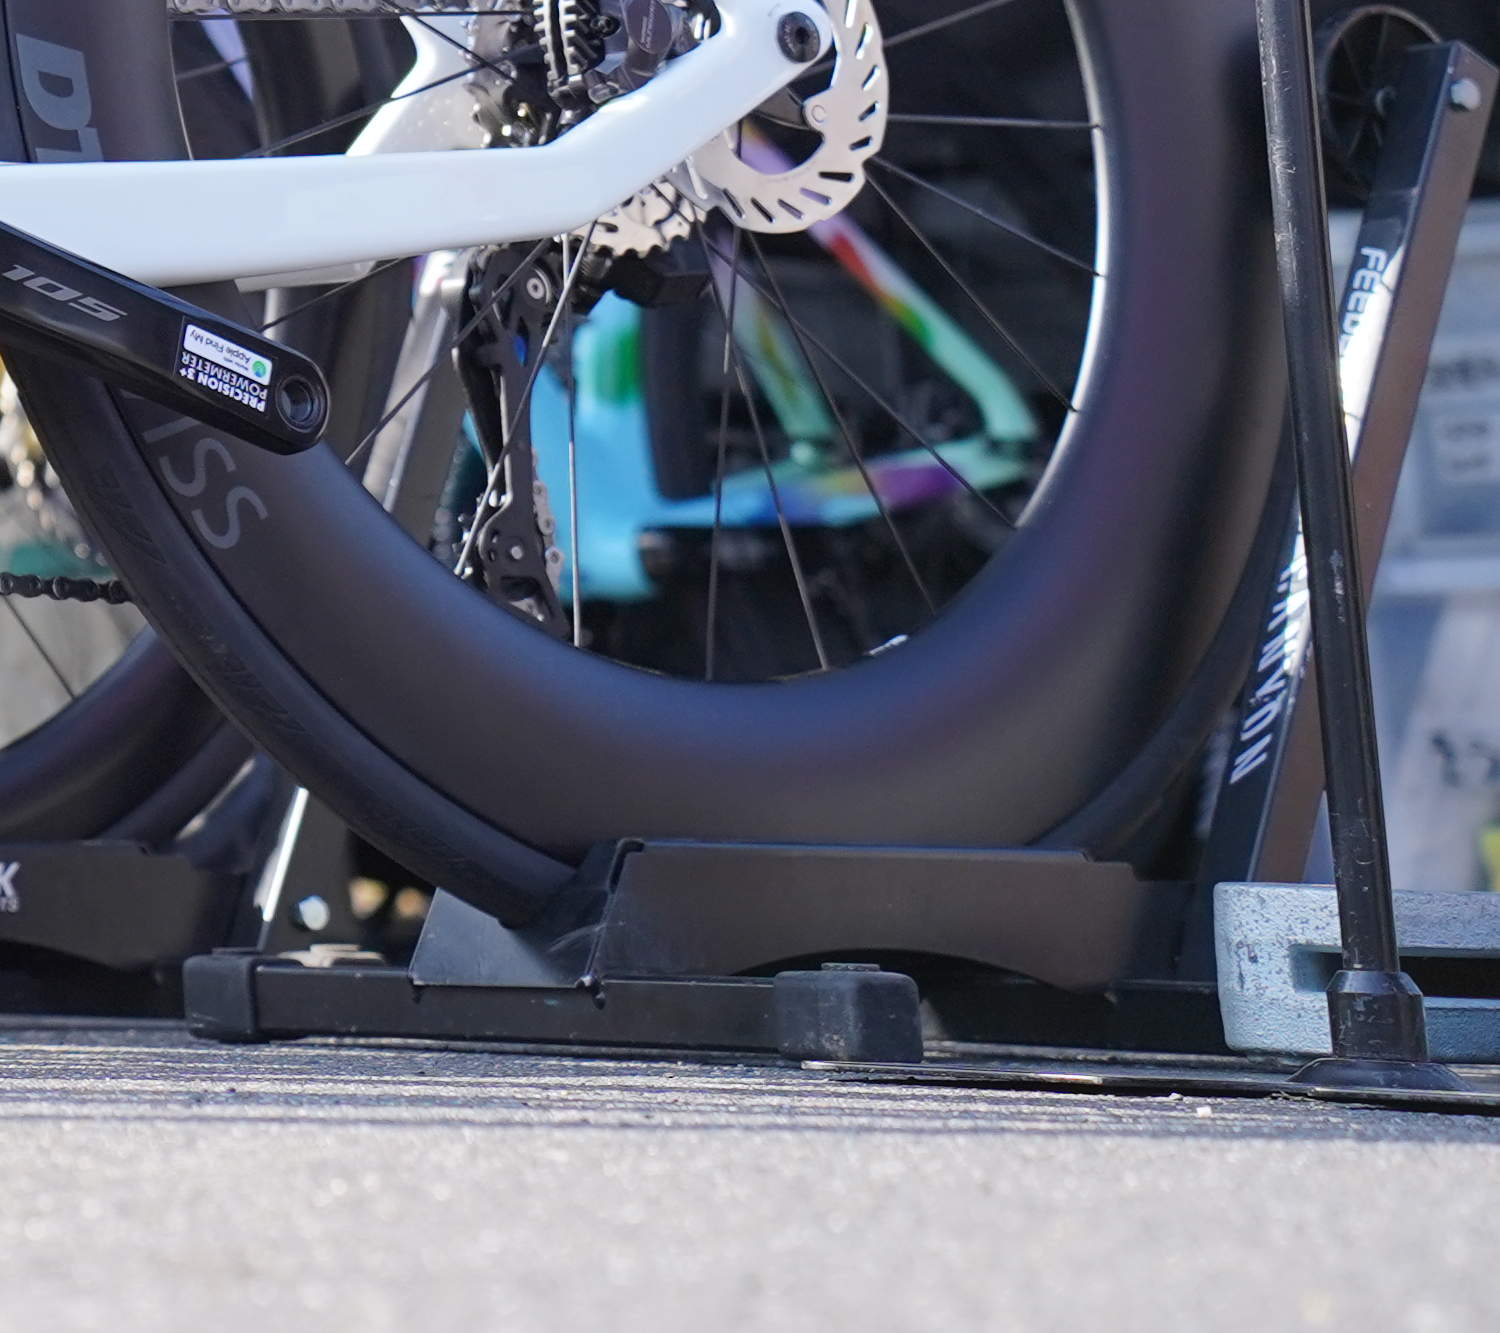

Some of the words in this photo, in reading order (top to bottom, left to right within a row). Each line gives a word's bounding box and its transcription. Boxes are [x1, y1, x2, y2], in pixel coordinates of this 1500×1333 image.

[1, 263, 129, 322] 105
[1338, 245, 1388, 357] FEED
[188, 329, 204, 345] My
[204, 337, 225, 353] Find
[225, 348, 252, 364] Apple
[180, 351, 268, 400] POWERMETER
[197, 373, 266, 413] PRECISION
[132, 393, 270, 550] ISS
[1230, 558, 1309, 786] ANYON
